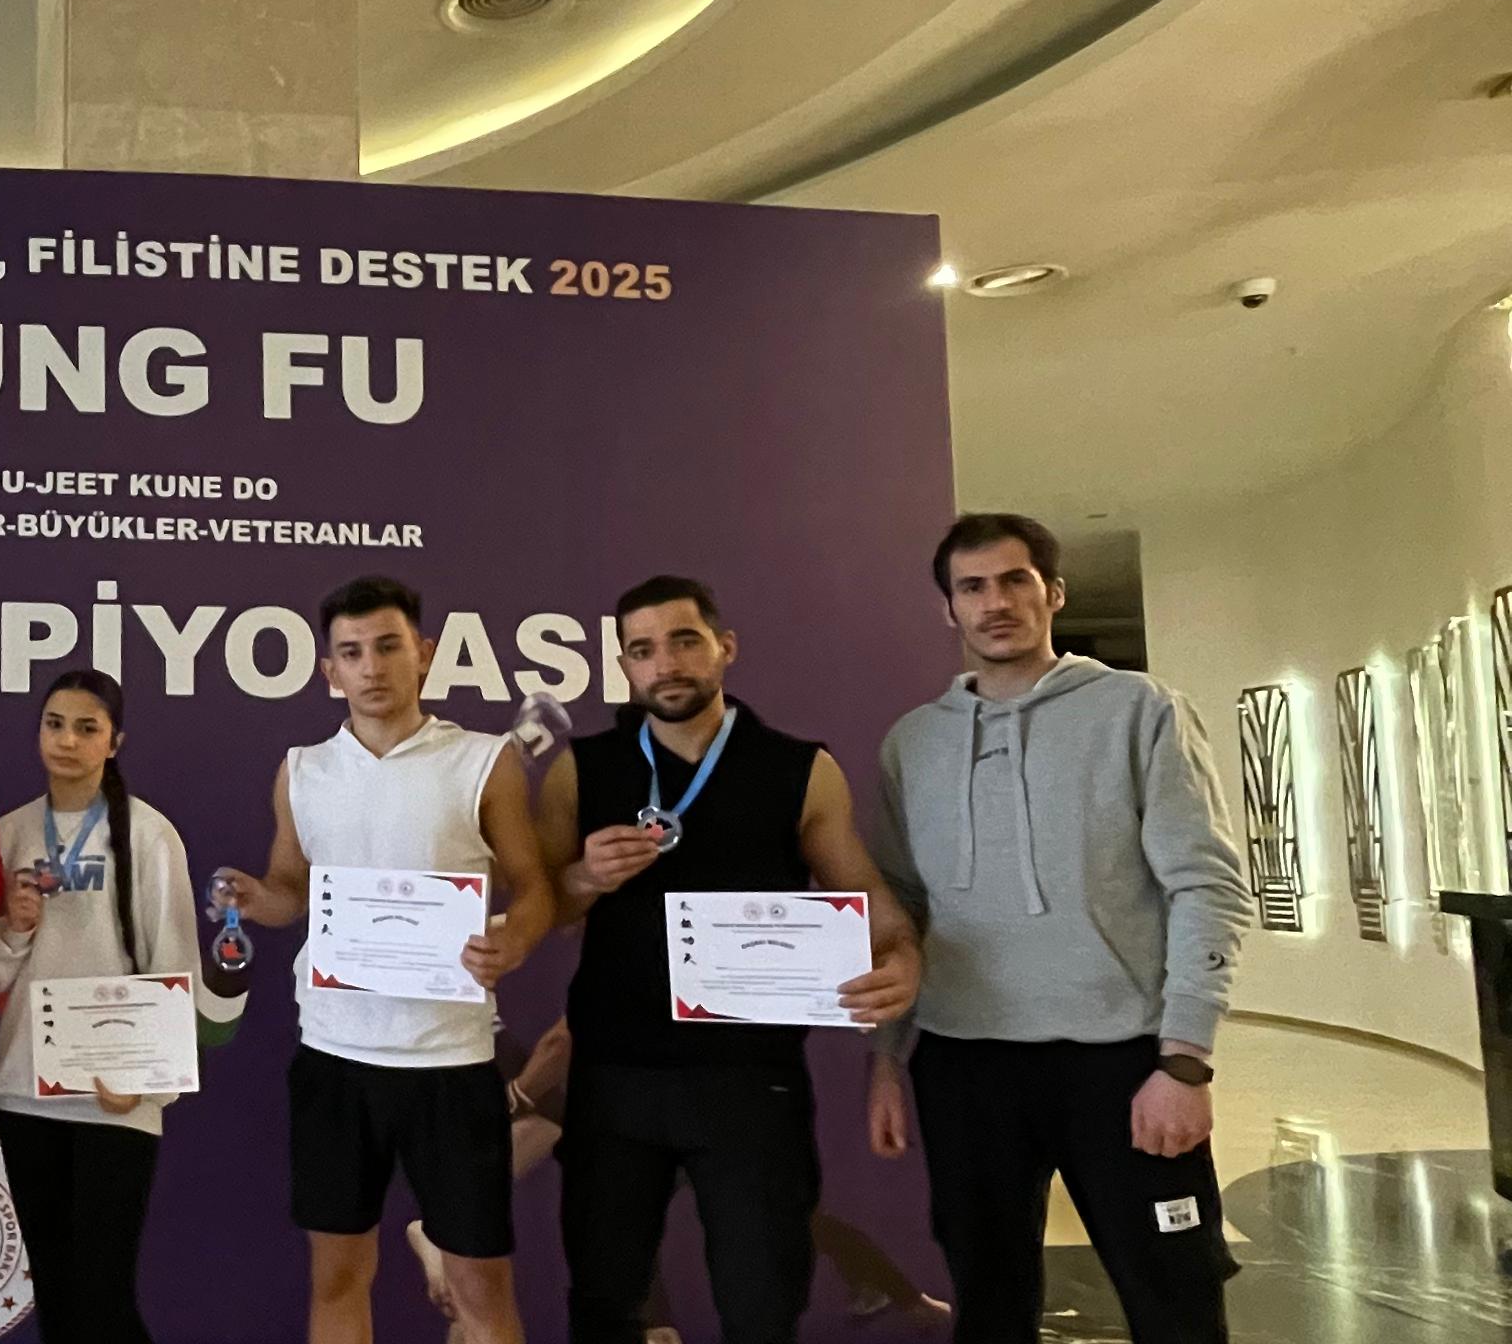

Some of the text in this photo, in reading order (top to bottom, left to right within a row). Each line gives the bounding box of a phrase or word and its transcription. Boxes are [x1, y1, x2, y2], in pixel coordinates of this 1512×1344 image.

[28, 229, 301, 283] FİLİSTİNE
[319, 248, 533, 294] DESTEK
[550, 259, 672, 301] 2025
[262, 332, 424, 425] FU
[129, 473, 223, 499] KUNE
[233, 476, 278, 501] DO
[0, 1204, 17, 1240] SPOR
